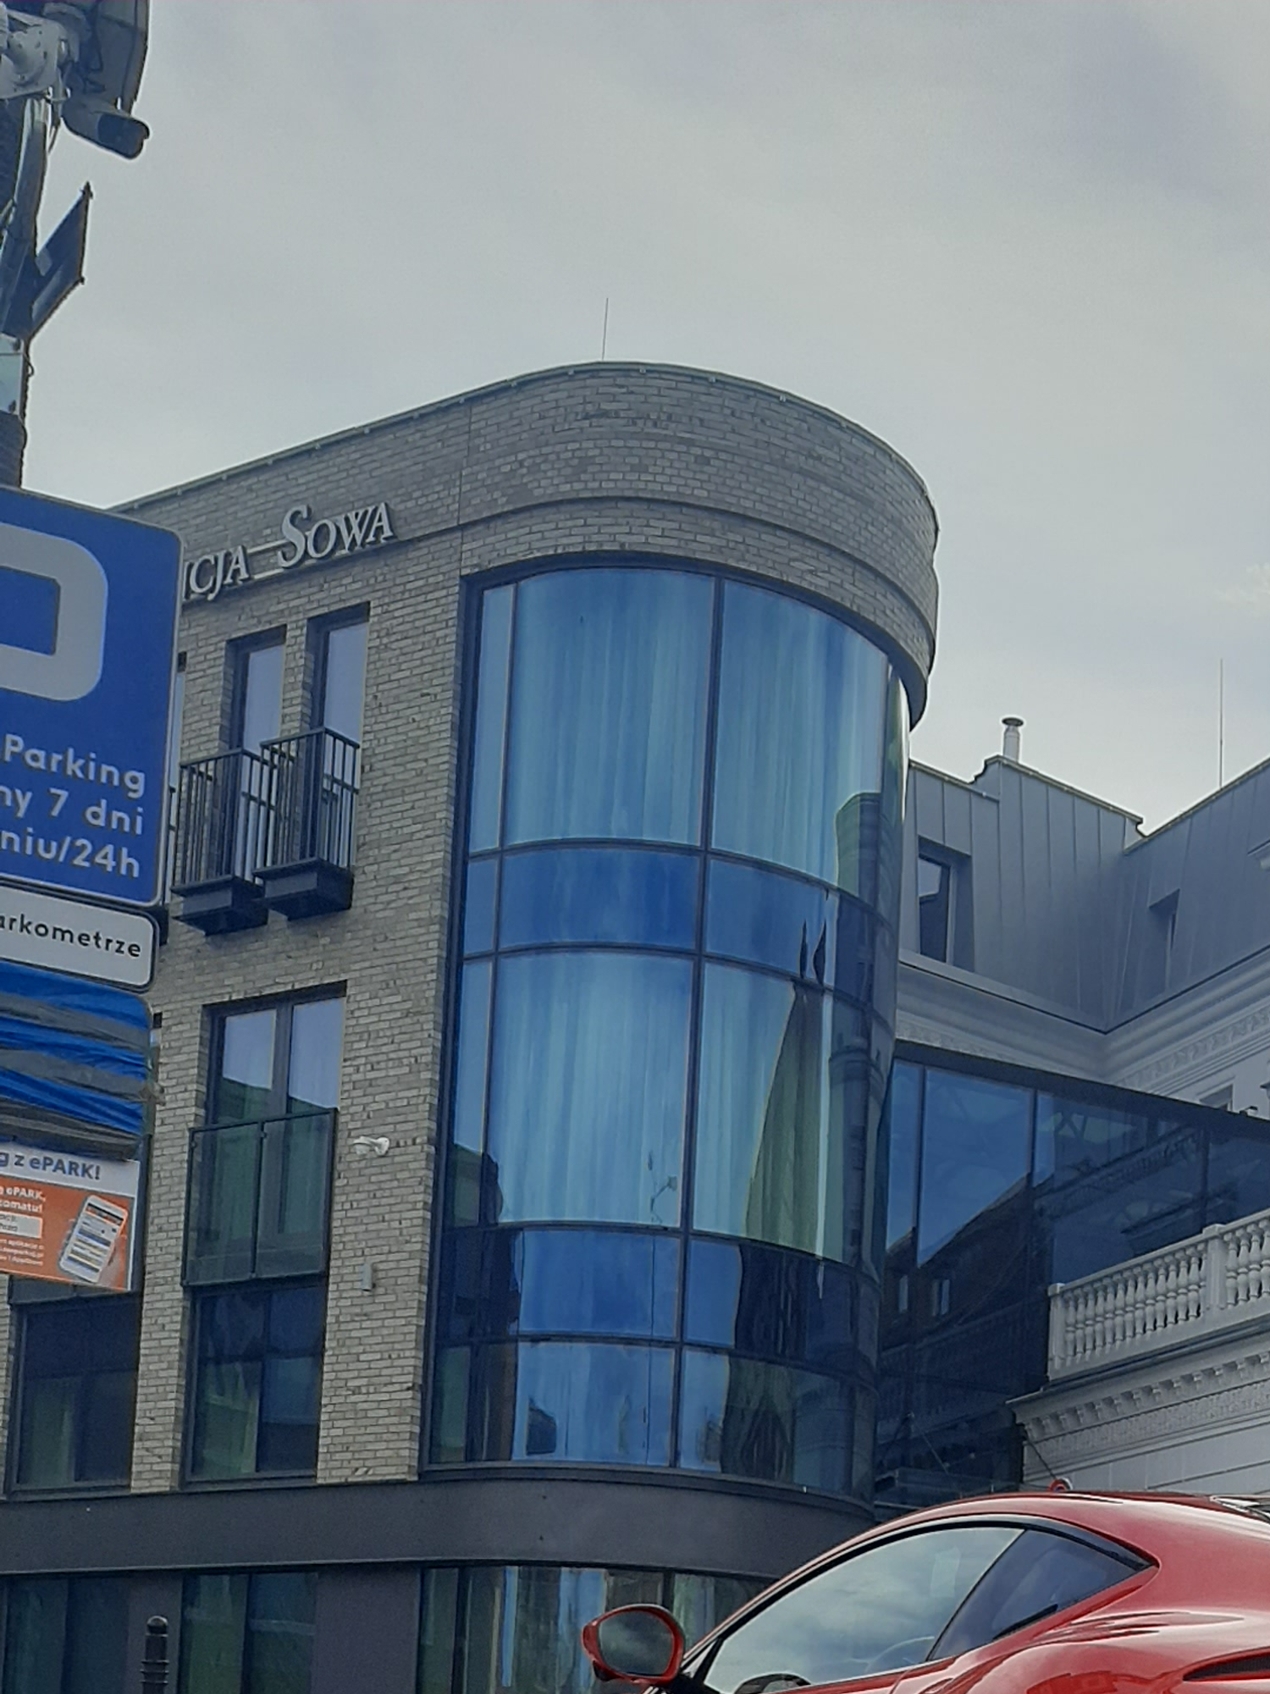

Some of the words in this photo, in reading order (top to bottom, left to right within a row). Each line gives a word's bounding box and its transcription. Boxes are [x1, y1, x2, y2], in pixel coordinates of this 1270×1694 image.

[278, 502, 394, 568] SOWA
[4, 734, 146, 799] Parking
[49, 788, 69, 817] 7
[85, 799, 144, 836] dni
[0, 827, 140, 878] niu/24h
[14, 1155, 25, 1167] z
[29, 1156, 101, 1181] ePARK!
